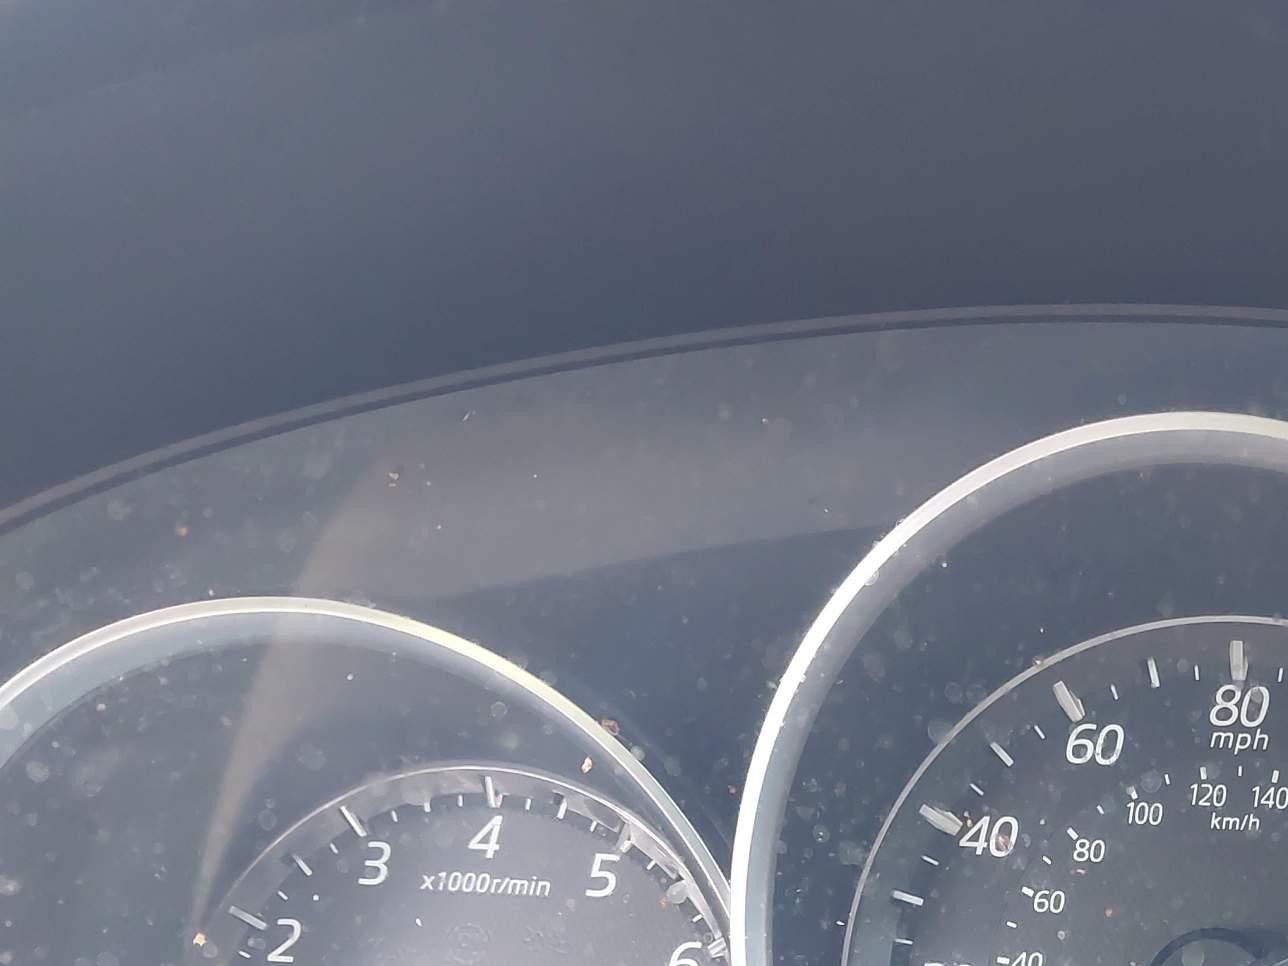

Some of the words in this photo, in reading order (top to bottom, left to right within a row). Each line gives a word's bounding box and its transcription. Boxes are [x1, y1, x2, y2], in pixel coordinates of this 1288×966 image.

[1209, 684, 1269, 727] 80
[1065, 723, 1124, 765] 60
[1209, 730, 1269, 754] mph
[1189, 783, 1227, 807] 120
[1126, 801, 1163, 825] 100
[1210, 812, 1260, 831] km/h
[468, 815, 503, 859] 4
[959, 816, 1018, 857] 40
[1073, 839, 1105, 862] 80
[358, 841, 391, 885] 3
[585, 854, 618, 897] 5
[420, 872, 551, 896] x1000r/min
[1033, 890, 1065, 913] 60
[267, 919, 302, 963] 2
